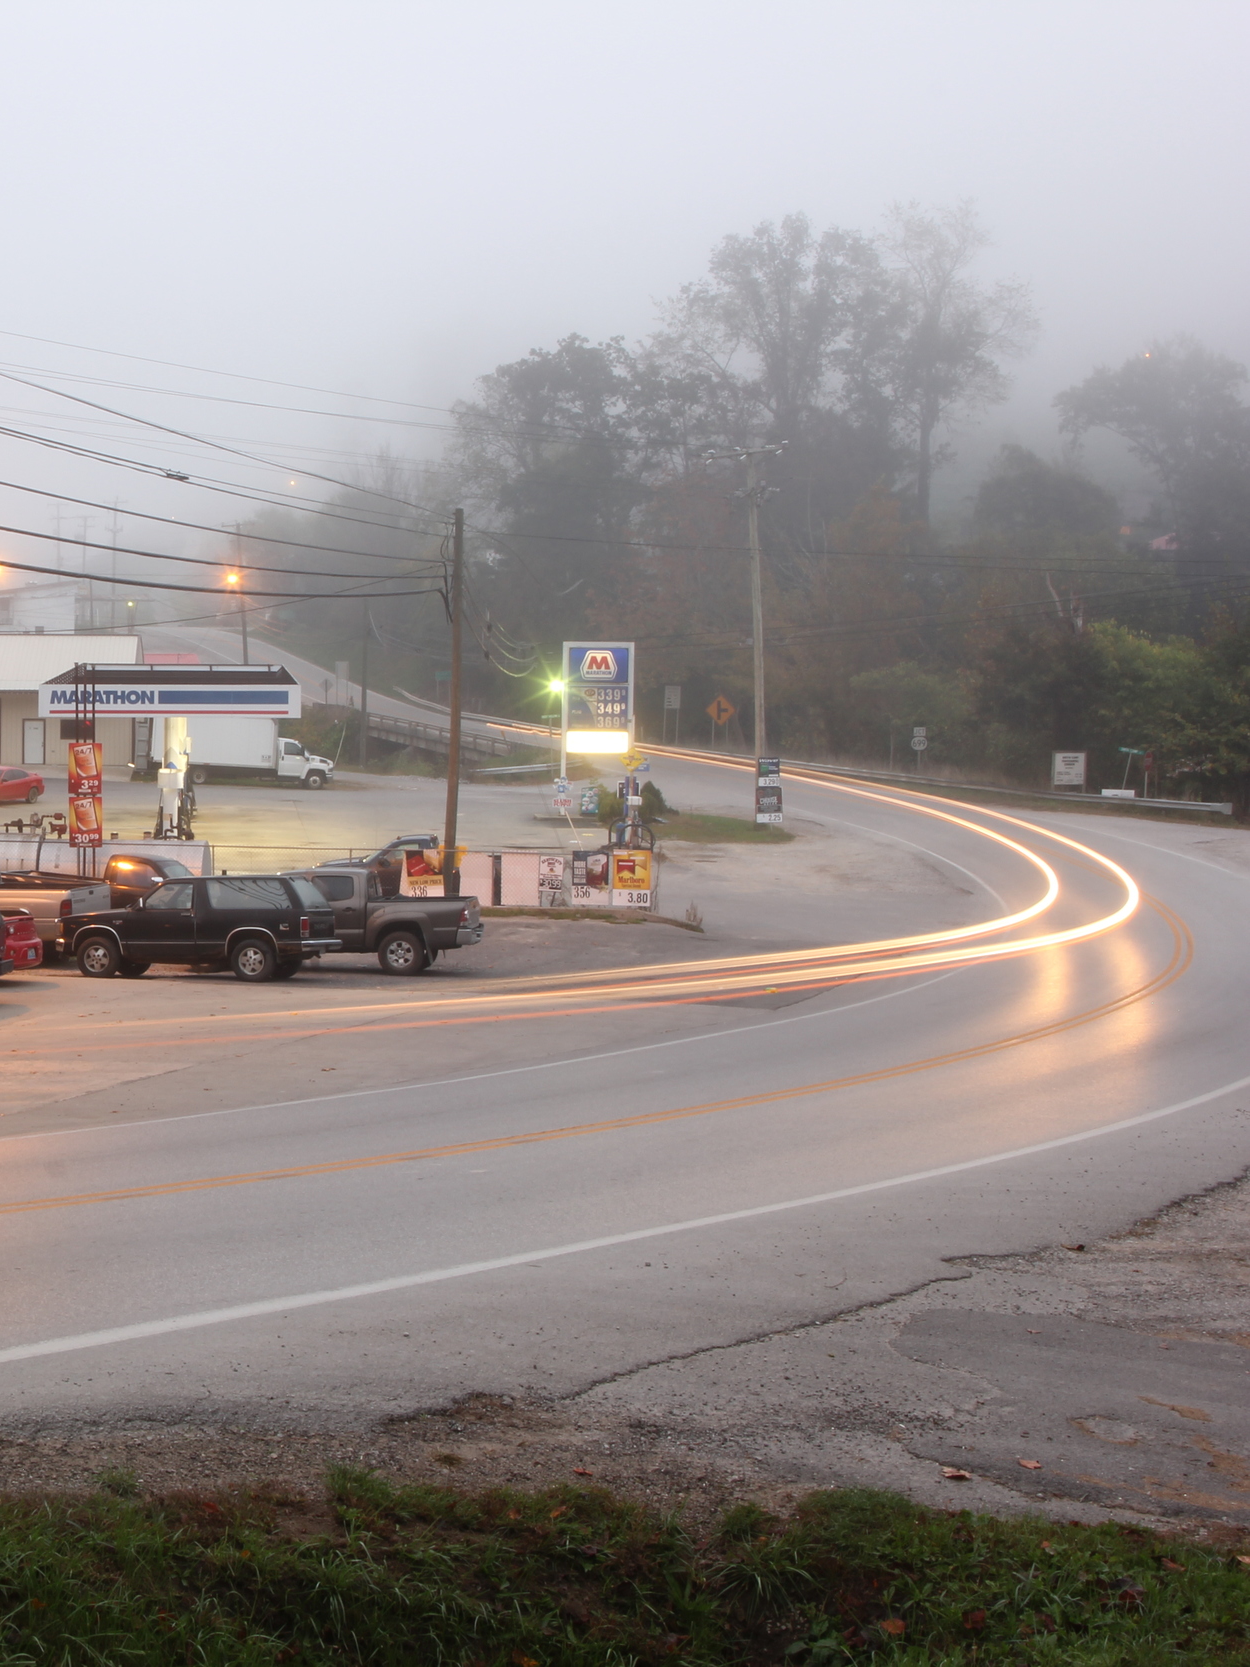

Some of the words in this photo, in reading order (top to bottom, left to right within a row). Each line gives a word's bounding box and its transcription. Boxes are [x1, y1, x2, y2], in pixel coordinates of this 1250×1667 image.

[587, 656, 610, 670] M
[50, 690, 155, 705] MARATHON
[912, 739, 926, 748] 699
[74, 747, 92, 756] 24/7
[74, 801, 92, 810] 24/7
[618, 876, 646, 884] Marlboro
[411, 885, 428, 897] 336
[573, 886, 590, 899] 356
[627, 892, 648, 904] 3.80
